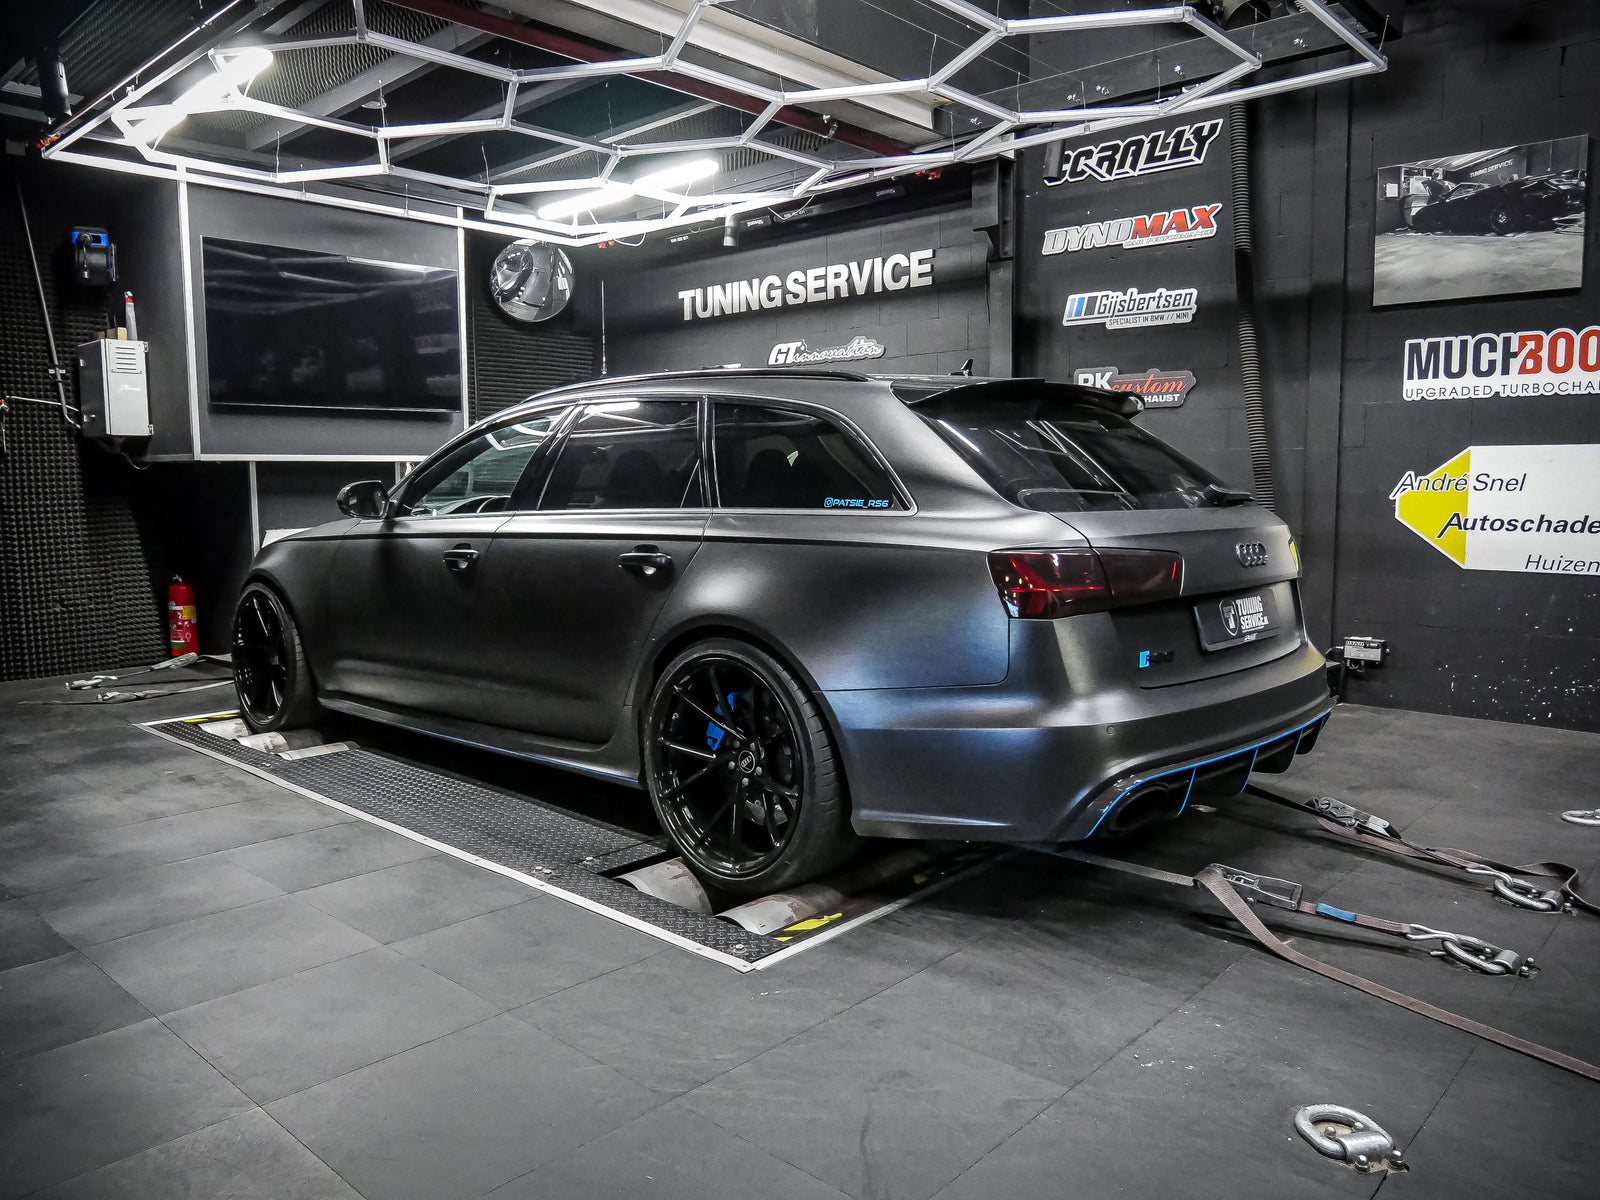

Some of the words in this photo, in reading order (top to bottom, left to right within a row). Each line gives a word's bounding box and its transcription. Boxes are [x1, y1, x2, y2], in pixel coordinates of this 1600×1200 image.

[1044, 119, 1223, 186] CRALLY
[1488, 159, 1513, 172] SERVICE
[1043, 205, 1220, 254] DYNOMAX
[1097, 292, 1193, 318] Gijsbertsen
[1109, 316, 1140, 326] SPECIALIST
[1176, 312, 1189, 320] MINI
[1112, 374, 1188, 395] custom
[1405, 386, 1493, 398] UPGRADED
[1501, 380, 1600, 395] TURBOCHA
[1143, 394, 1180, 403] HAUST
[1392, 472, 1469, 498] André
[1473, 473, 1527, 492] Snel
[1436, 512, 1600, 539] Autoschade
[1525, 554, 1600, 572] Huizen
[1236, 596, 1263, 616] TUNING
